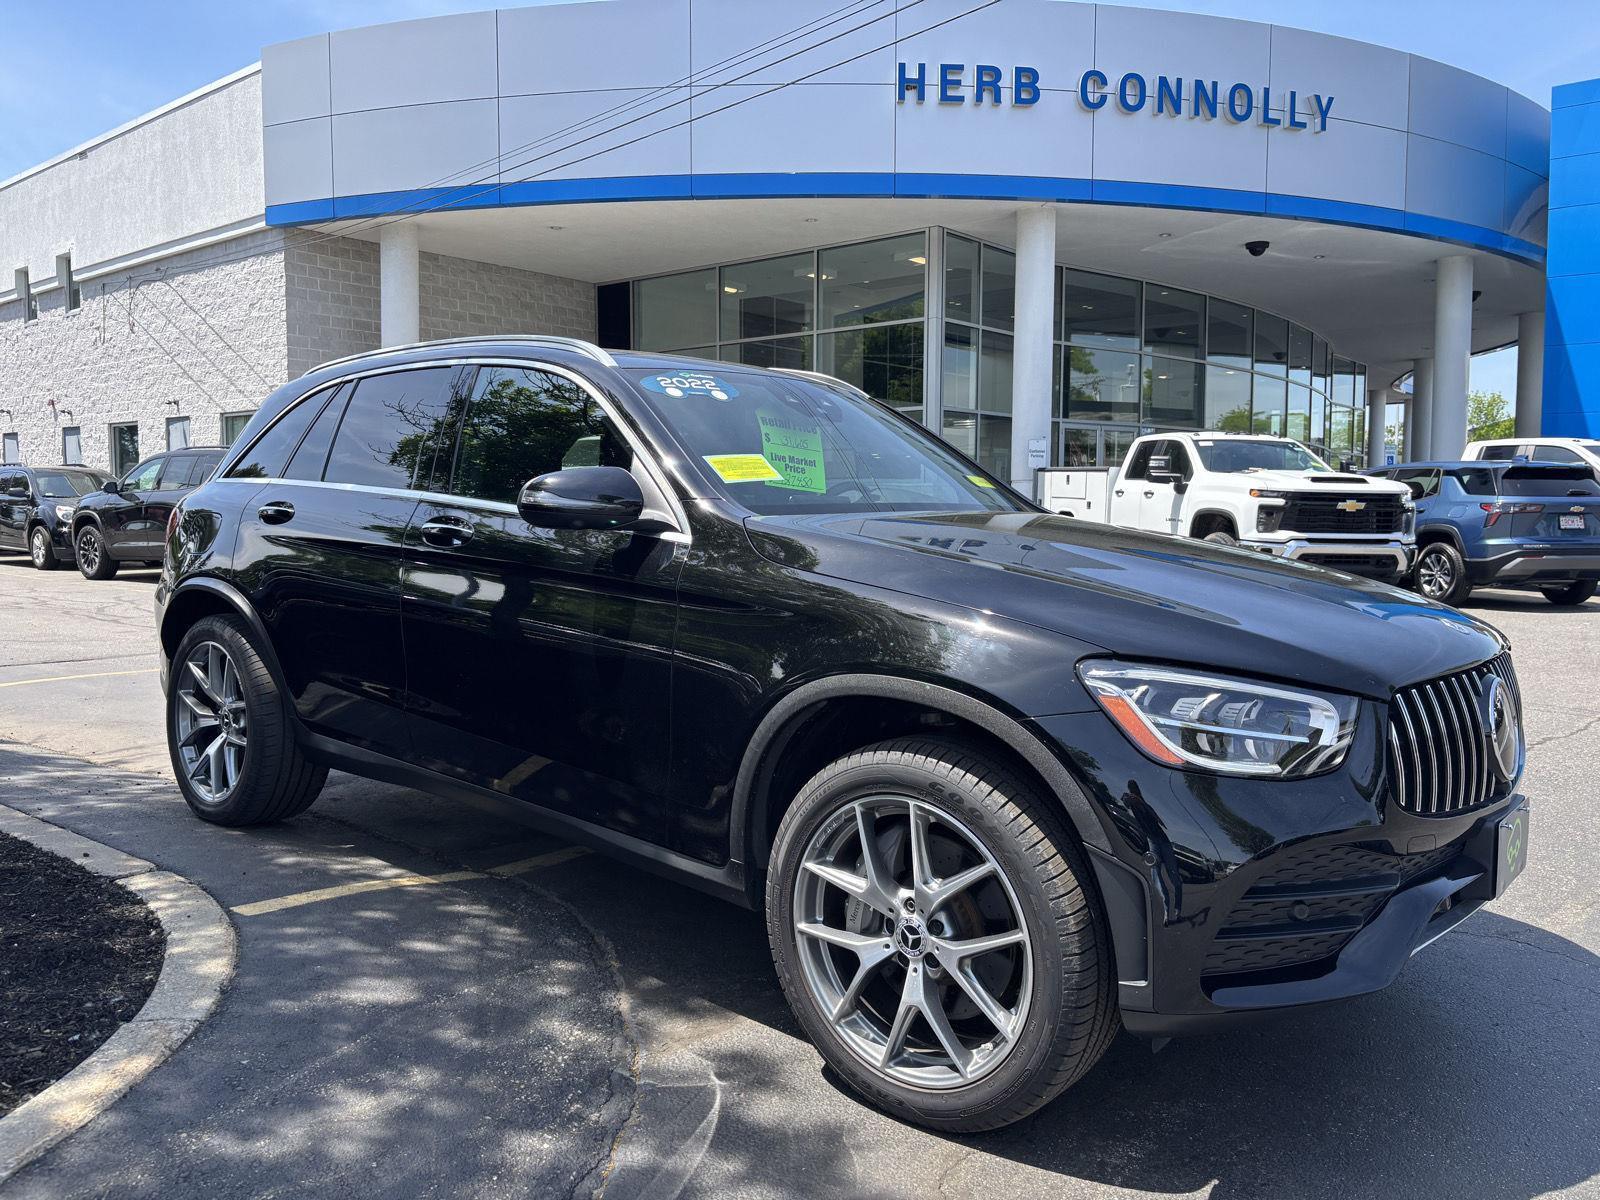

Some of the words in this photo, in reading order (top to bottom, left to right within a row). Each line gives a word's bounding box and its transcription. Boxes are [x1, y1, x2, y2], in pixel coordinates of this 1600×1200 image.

[897, 62, 1041, 106] HERB
[1078, 69, 1335, 133] CONNOLLY
[656, 376, 721, 391] 2022
[770, 452, 787, 463] Live
[788, 455, 817, 468] Market
[784, 463, 806, 475] Price
